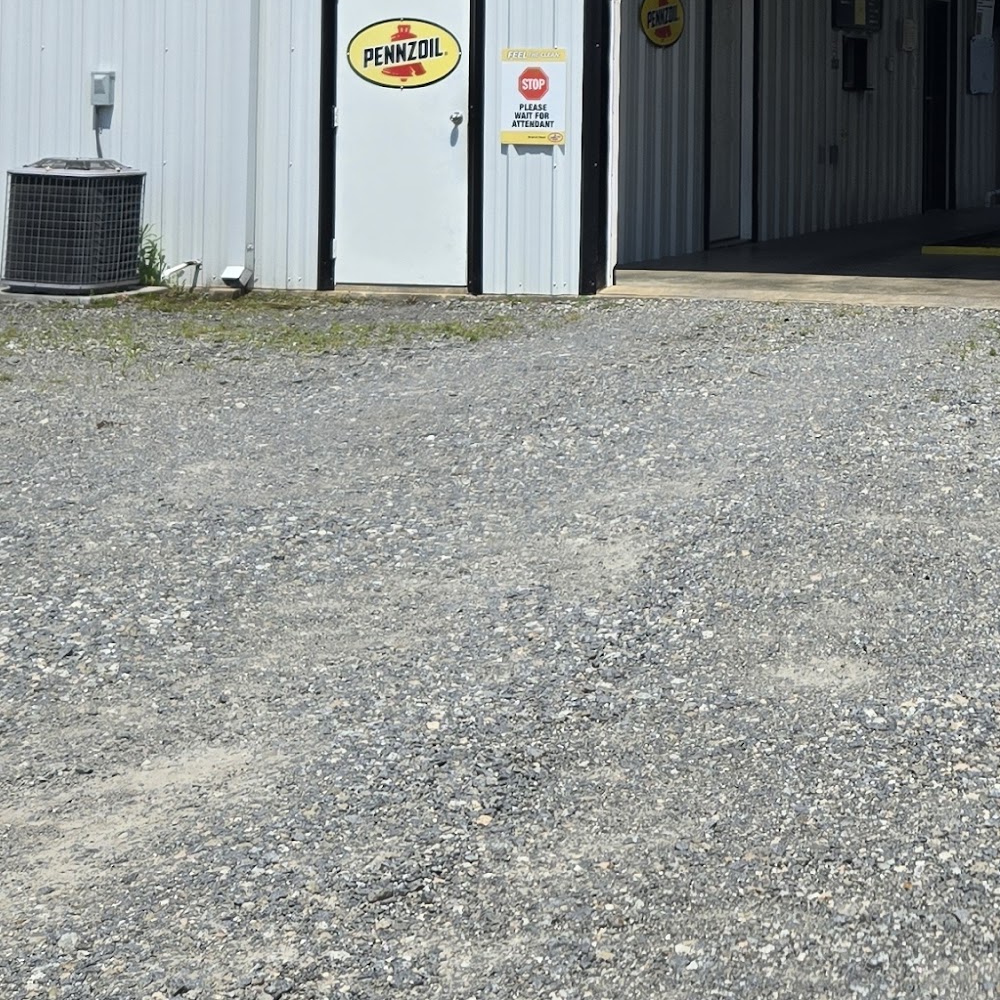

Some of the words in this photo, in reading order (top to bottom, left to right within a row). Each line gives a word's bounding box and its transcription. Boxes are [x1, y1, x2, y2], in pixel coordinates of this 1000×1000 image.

[647, 5, 679, 29] PENNZOIL
[363, 37, 443, 68] PENNZOIL
[508, 51, 527, 59] FEEL
[522, 78, 545, 90] STOP
[519, 103, 547, 111] PLEASE
[511, 120, 554, 128] ATTENDANT
